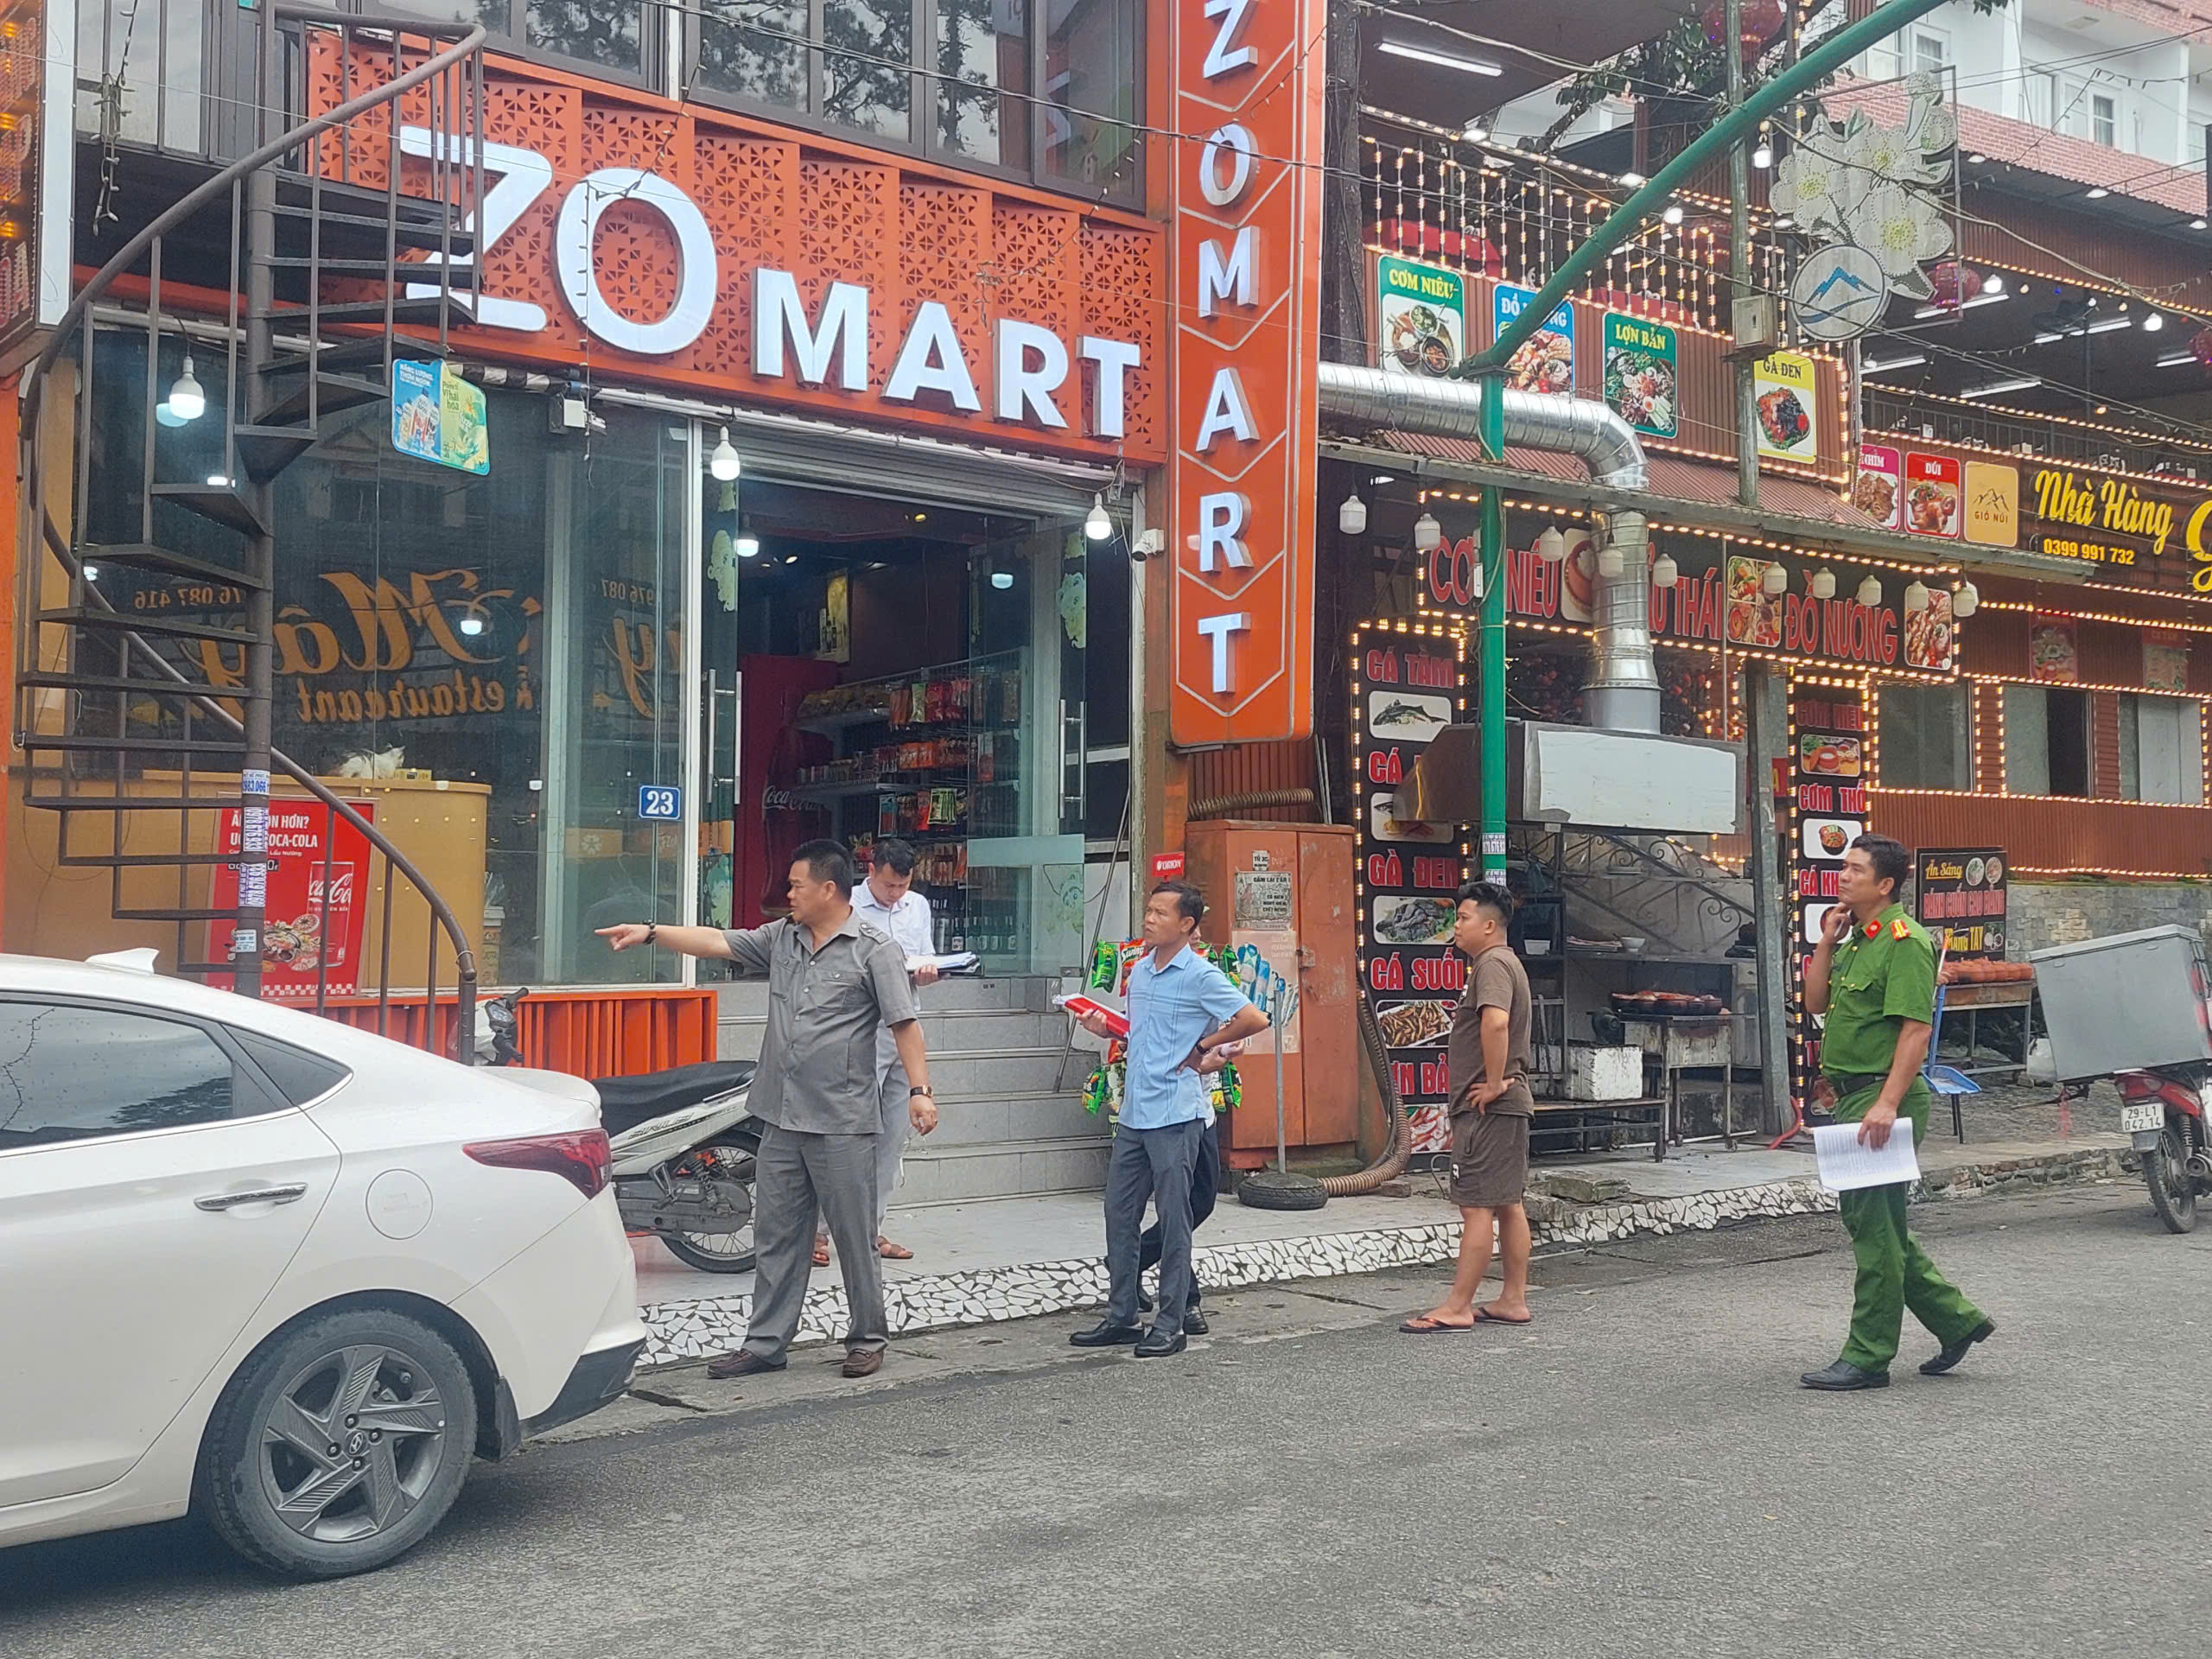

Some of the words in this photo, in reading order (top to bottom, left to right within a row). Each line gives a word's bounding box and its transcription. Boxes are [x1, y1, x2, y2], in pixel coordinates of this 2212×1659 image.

[399, 125, 717, 354] ZO
[751, 267, 1141, 437] MART
[1389, 269, 1418, 290] CƠM
[1421, 276, 1455, 299] NIÊU
[1615, 324, 1639, 346] LỢN
[1763, 358, 1778, 374] GÀ
[1925, 461, 1942, 475] DÚI
[2035, 470, 2096, 526] Nhà
[2101, 479, 2174, 555] Hàng
[2044, 538, 2078, 557] 0399
[2081, 543, 2105, 561] 991
[2109, 548, 2135, 565] 732
[1429, 536, 1474, 606] CƠ
[1506, 539, 1559, 619] NIÊU
[1671, 567, 1722, 640] THÁI
[1366, 645, 1399, 683] CÁ
[1368, 747, 1402, 785] CÁ
[646, 791, 674, 815] 23
[1799, 782, 1832, 812] CƠM
[281, 813, 309, 829] HƠN?
[268, 834, 318, 848] OCA-COLA
[1368, 849, 1403, 887] GÀ
[1370, 952, 1404, 990] CÁ
[1411, 947, 1464, 990] SUỐI
[1421, 1052, 1450, 1095] BẢ
[2125, 1116, 2161, 1130] 042.14
[2127, 1105, 2157, 1120] 29-L1
